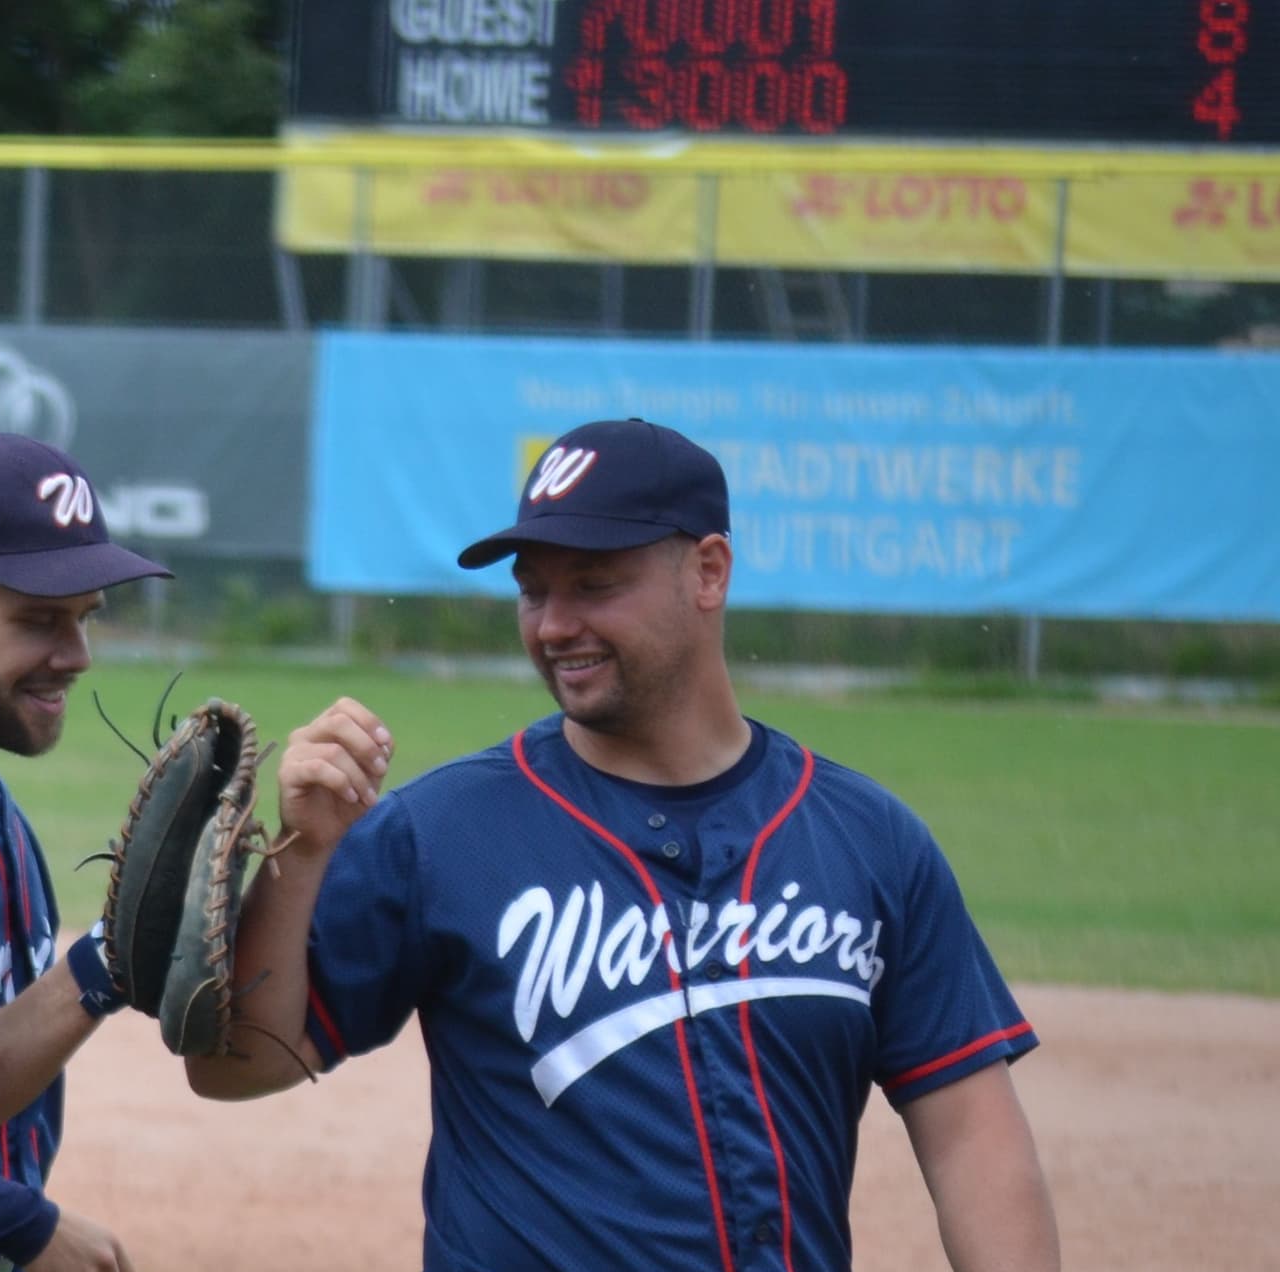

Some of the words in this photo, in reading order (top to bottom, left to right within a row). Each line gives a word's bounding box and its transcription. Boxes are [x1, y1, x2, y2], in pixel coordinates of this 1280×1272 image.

[398, 49, 552, 124] HOME
[1192, 68, 1242, 142] 4
[862, 174, 1026, 223] LOTTO
[36, 471, 95, 529] W
[528, 444, 601, 505] W
[716, 439, 1082, 508] TADTWERKE
[496, 879, 887, 1045] Warriors
